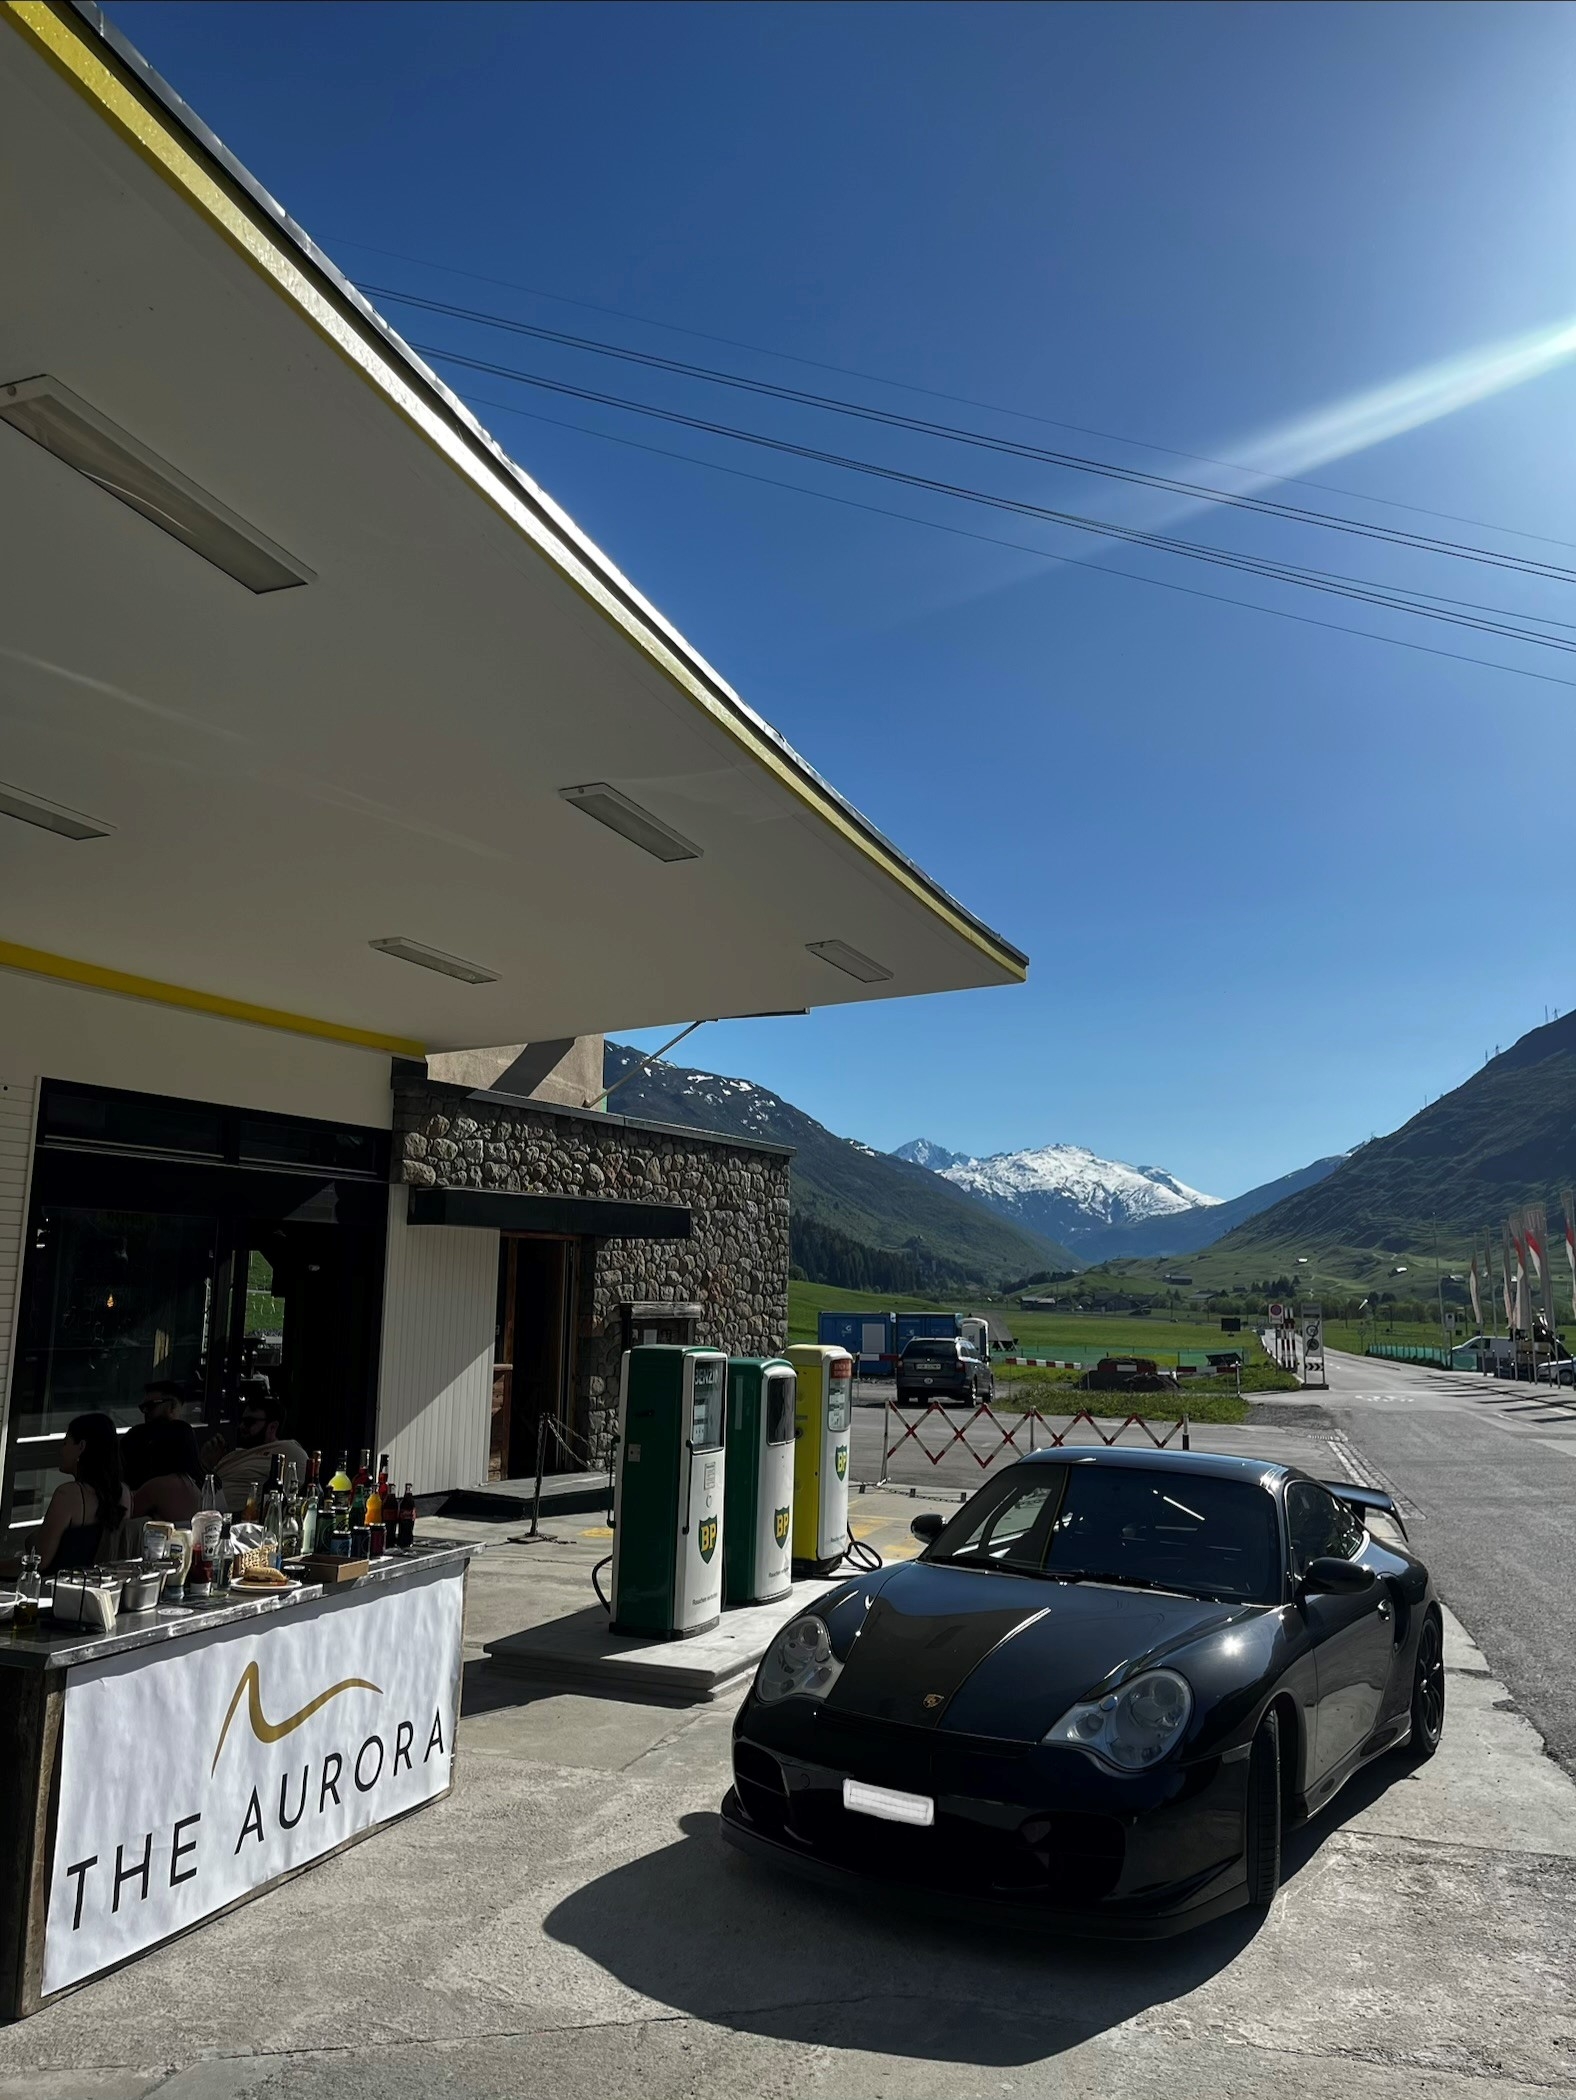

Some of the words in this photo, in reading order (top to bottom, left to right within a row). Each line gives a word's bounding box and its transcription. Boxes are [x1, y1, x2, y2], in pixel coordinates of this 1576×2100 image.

[837, 1450, 847, 1473] BP
[701, 1522, 717, 1553] BP
[776, 1512, 789, 1539] BP
[67, 1812, 201, 1931] THE
[234, 1706, 445, 1855] AURORA
